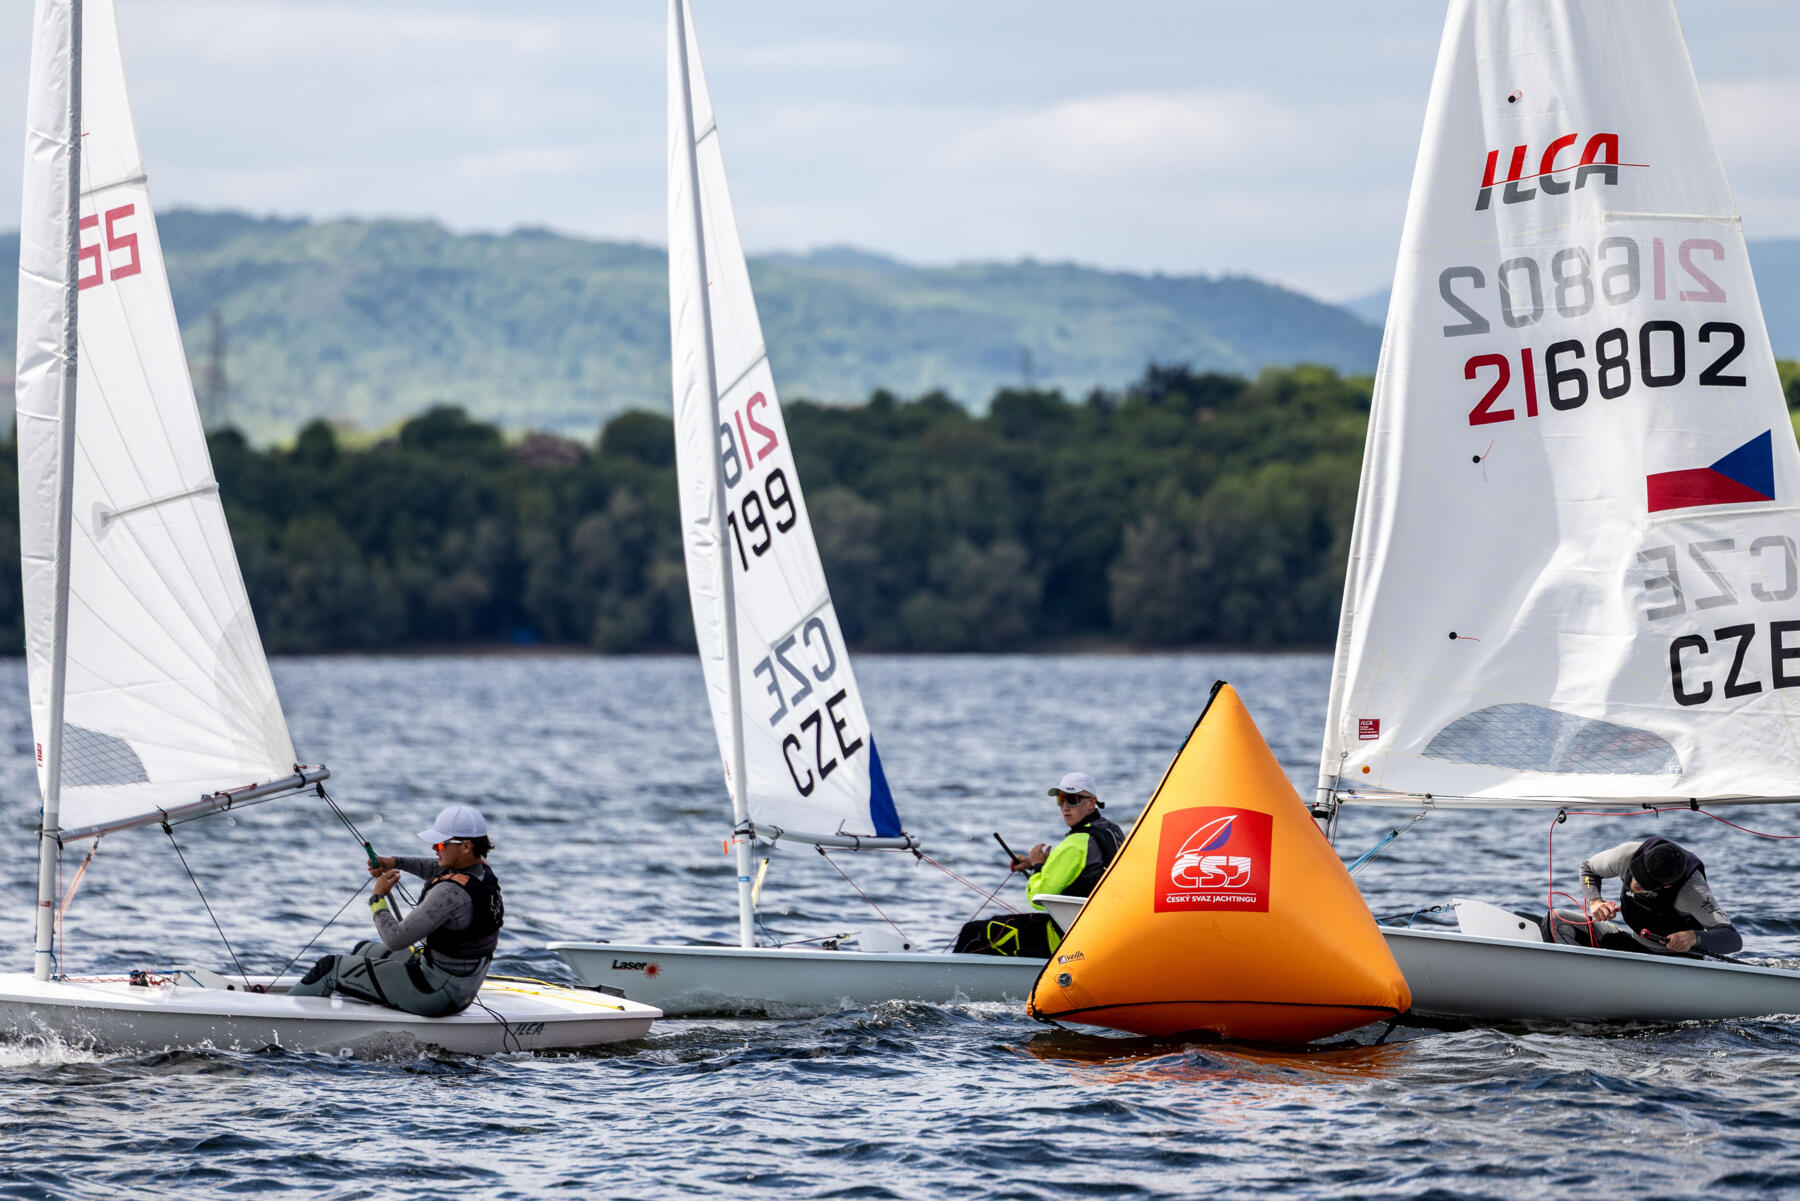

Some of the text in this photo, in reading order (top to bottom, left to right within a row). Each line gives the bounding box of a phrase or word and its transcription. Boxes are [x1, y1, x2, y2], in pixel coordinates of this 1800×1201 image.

[1475, 132, 1619, 211] ILCA
[1463, 320, 1747, 427] 216802
[728, 467, 797, 573] 199
[1669, 620, 1800, 707] CZE
[782, 688, 864, 798] CZE
[1166, 895, 1190, 903] ČESKÝ
[1212, 895, 1257, 903] JACHTINGU
[612, 959, 647, 970] Laser
[513, 1022, 545, 1036] ILCA
